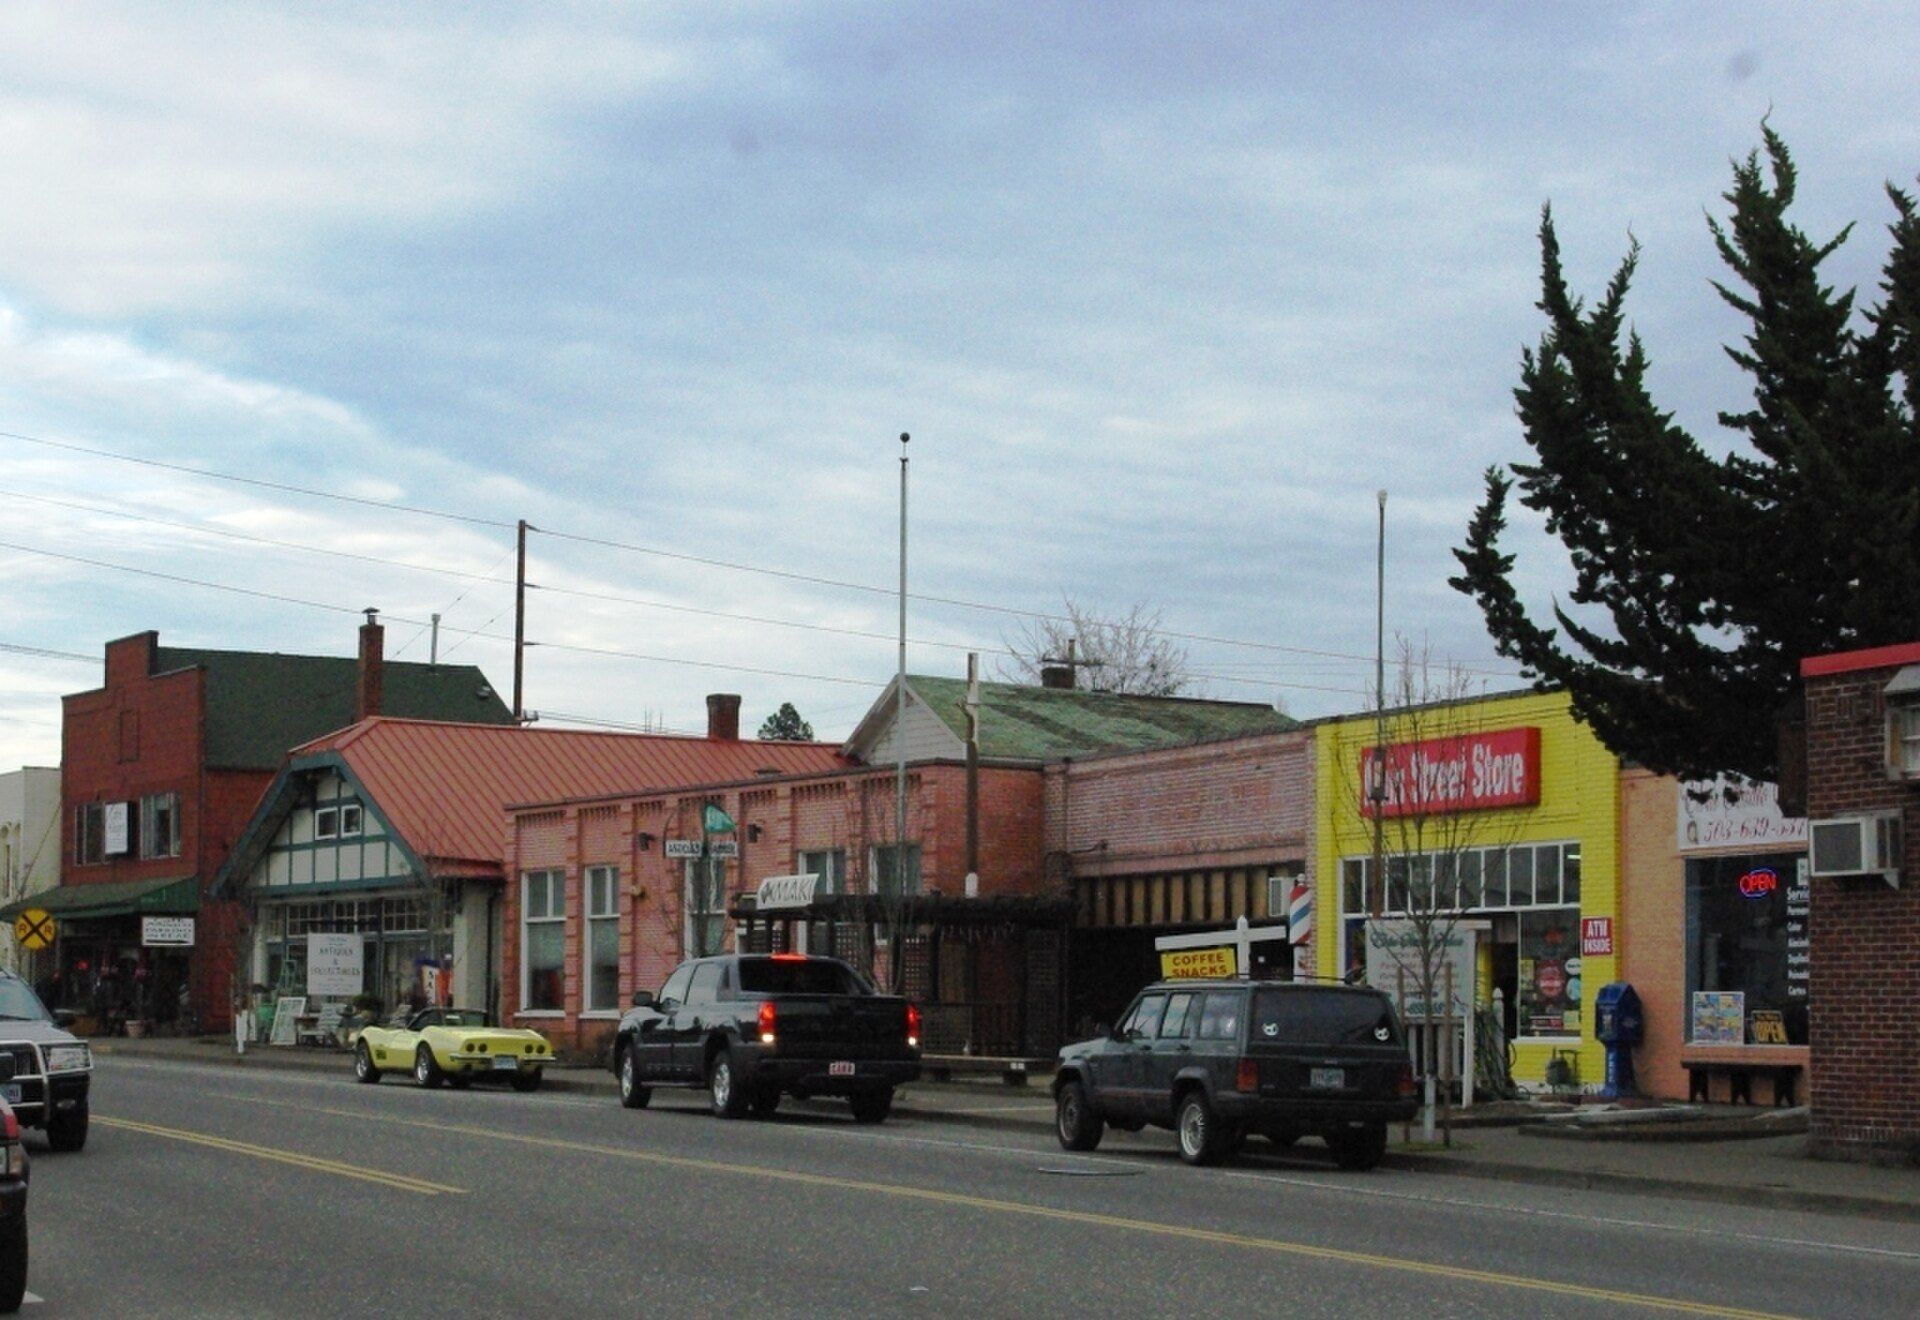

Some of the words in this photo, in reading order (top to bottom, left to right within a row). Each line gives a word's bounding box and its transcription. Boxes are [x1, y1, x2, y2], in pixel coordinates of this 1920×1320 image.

[1472, 743, 1524, 799] Store
[1740, 874, 1777, 892] OPEN
[1587, 919, 1608, 938] ATM
[1584, 940, 1611, 953] INSIDE
[1172, 952, 1225, 966] COFFEE
[1171, 965, 1227, 978] SNACKS
[1755, 1021, 1786, 1043] OPEN
